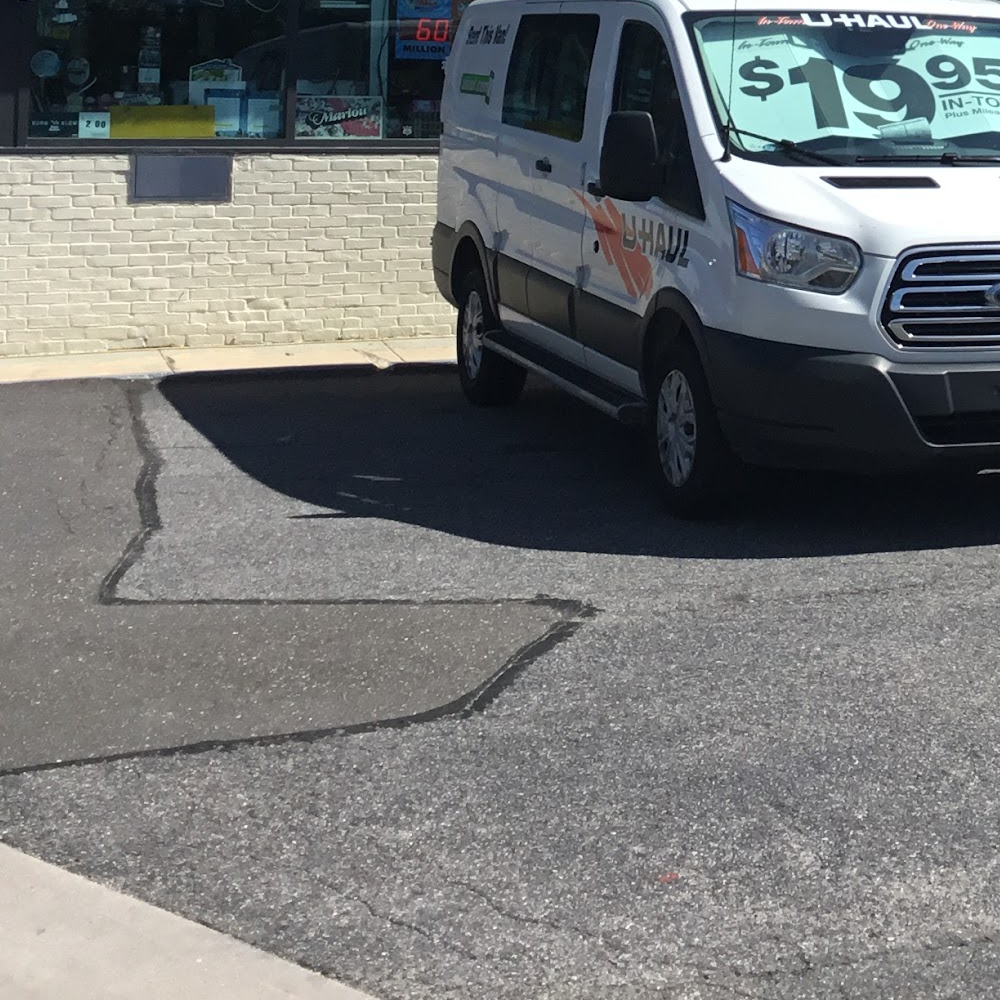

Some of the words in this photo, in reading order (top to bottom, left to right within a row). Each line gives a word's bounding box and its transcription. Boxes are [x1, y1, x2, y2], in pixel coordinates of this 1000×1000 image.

[801, 13, 933, 29] U-HAUL
[416, 18, 449, 42] 60
[403, 44, 445, 53] MILLION
[945, 109, 969, 119] Plus
[621, 212, 689, 268] U-HAUL
